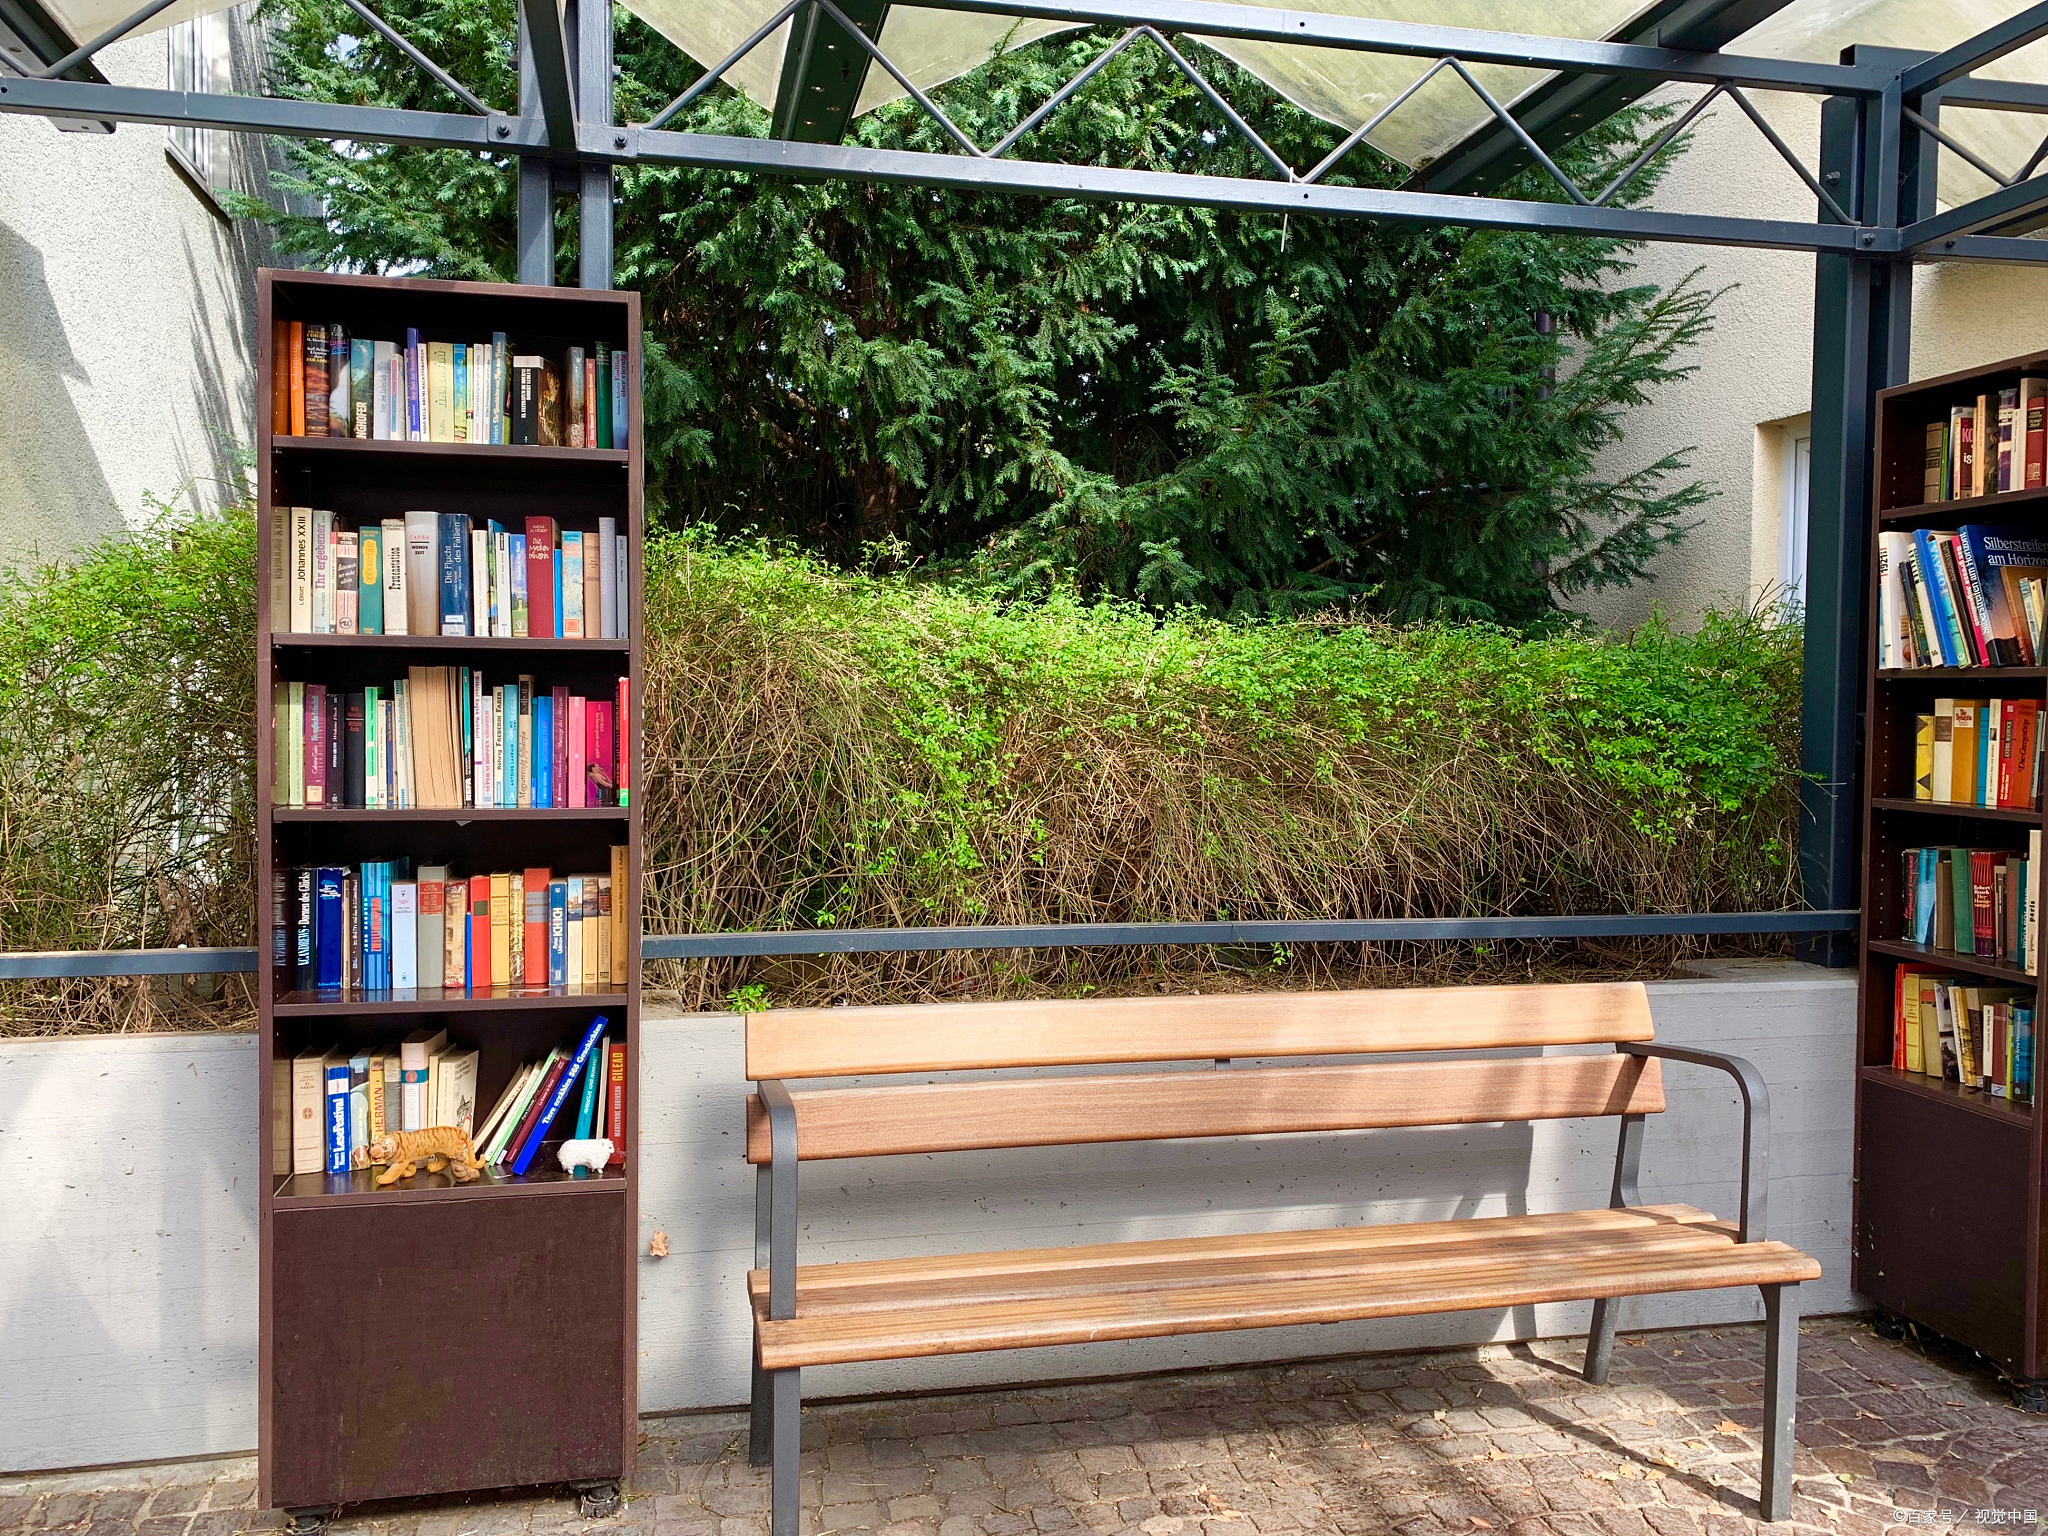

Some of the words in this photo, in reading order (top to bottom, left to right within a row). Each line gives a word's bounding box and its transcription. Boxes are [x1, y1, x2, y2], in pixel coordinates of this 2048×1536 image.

[297, 516, 306, 537] XXIII
[453, 522, 461, 548] Falken
[297, 539, 306, 581] Johannes
[443, 545, 453, 569] Flucht
[453, 549, 462, 563] des
[1959, 531, 1974, 567] Horizont
[1987, 554, 2006, 566] am
[388, 546, 401, 590] Frauenstation
[1929, 540, 1947, 587] ORAVA
[1969, 566, 1982, 581] am
[315, 572, 326, 590] Ihr
[444, 570, 453, 584] Die
[600, 560, 608, 595] MONICA
[1971, 580, 1990, 636] Silberstreifen
[298, 871, 311, 892] Glücks
[298, 892, 310, 902] des
[298, 903, 310, 925] Dornen
[552, 907, 563, 921] ICH
[552, 924, 563, 937] ICH
[542, 1106, 557, 1125] Tiere
[554, 1078, 573, 1106] erzählen
[576, 1023, 603, 1064] Geschichten
[612, 1052, 624, 1082] GILEAD
[374, 1087, 384, 1133] HERMAN
[614, 1085, 622, 1110] ROBINSON
[332, 1097, 345, 1153] LeseFestival
[614, 1109, 622, 1138] MARILYNNE
